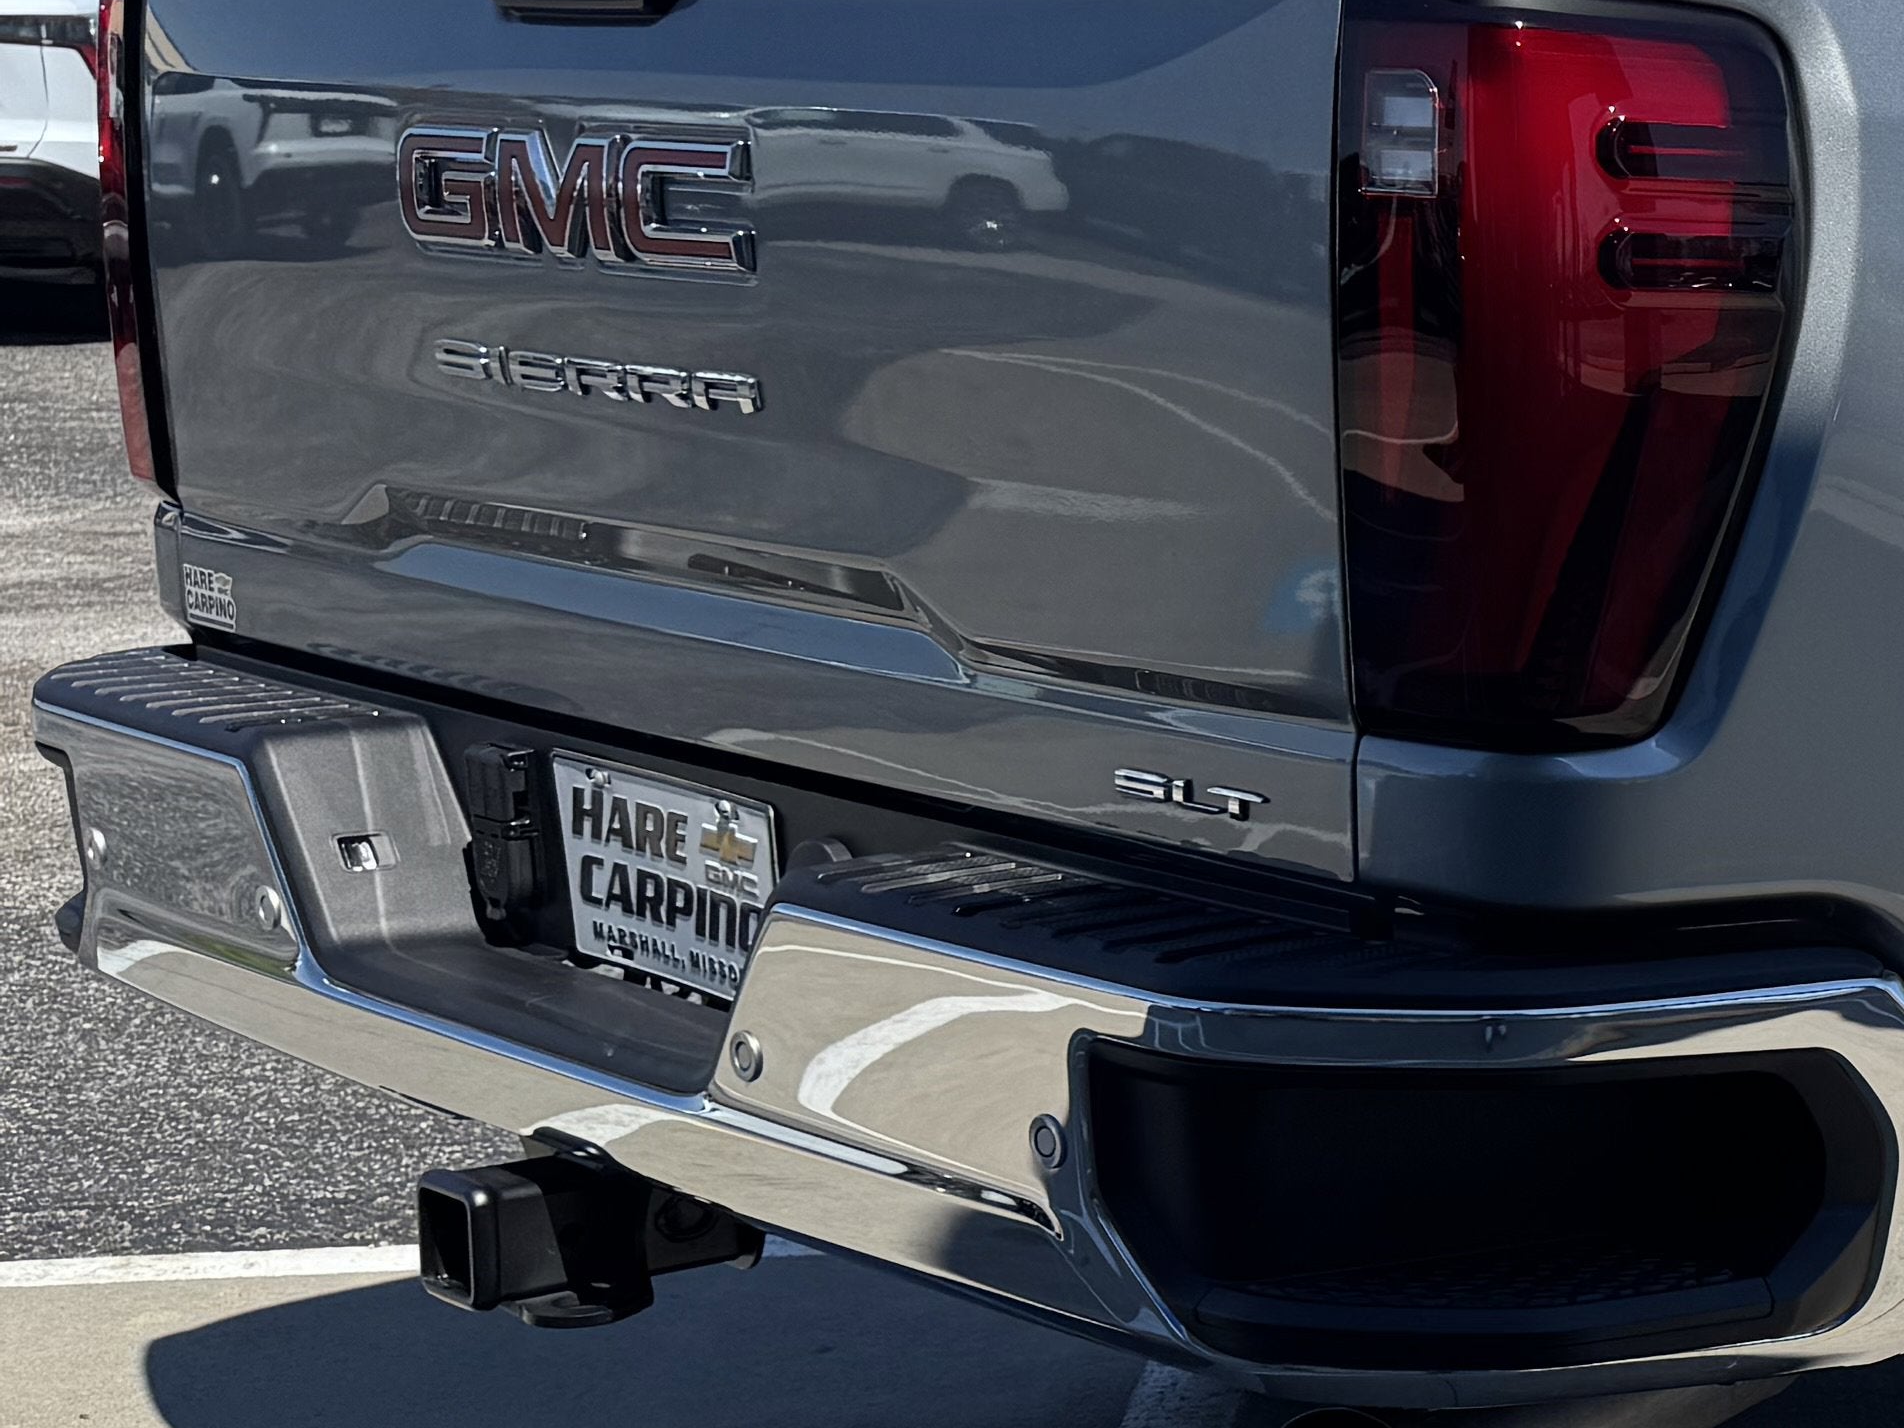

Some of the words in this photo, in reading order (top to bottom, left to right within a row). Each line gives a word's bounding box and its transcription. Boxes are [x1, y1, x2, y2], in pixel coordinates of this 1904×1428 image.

[397, 126, 758, 273] GMC
[435, 338, 764, 415] SIERRA
[184, 566, 215, 592] HARE
[187, 588, 234, 621] CARPINO
[1114, 767, 1271, 822] SLT
[571, 785, 689, 866] HARE
[704, 859, 761, 898] GMC
[689, 948, 741, 985] MISSO
